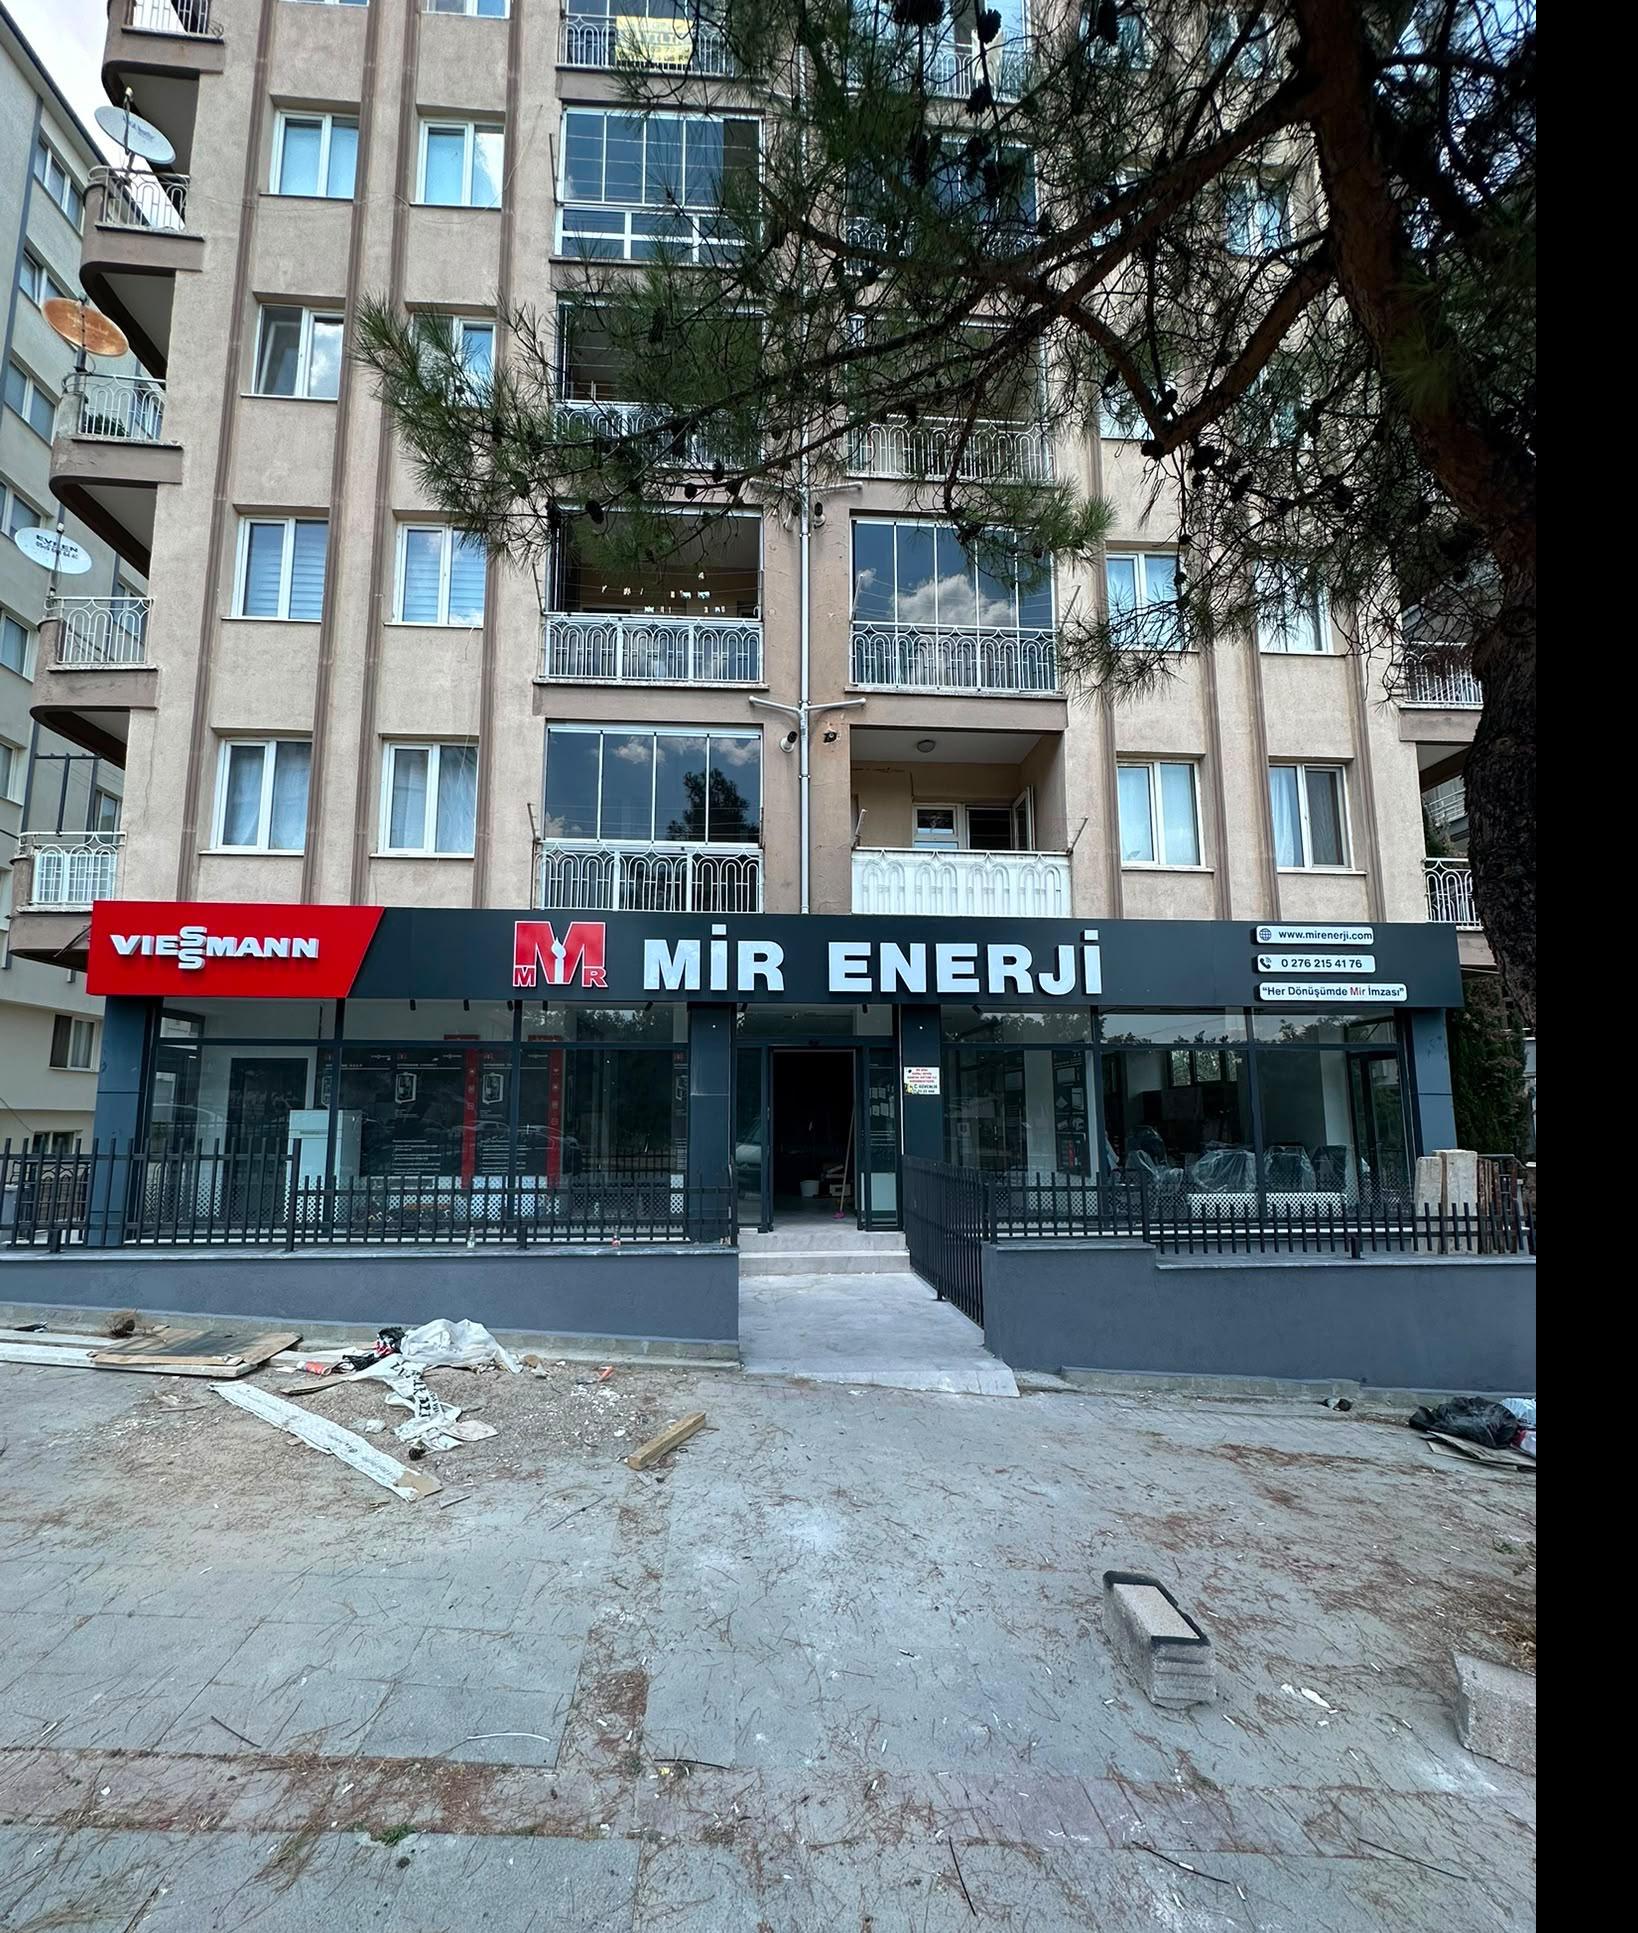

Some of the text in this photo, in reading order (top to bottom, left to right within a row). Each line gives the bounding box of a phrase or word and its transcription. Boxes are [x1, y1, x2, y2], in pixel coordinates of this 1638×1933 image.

[1278, 930, 1373, 941] www.mirenerji.com
[110, 926, 319, 969] VIESSMANN
[1281, 959, 1362, 968] 0 276 215 41 76
[1288, 986, 1348, 998] Dönüşümde
[1349, 986, 1366, 996] Mir
